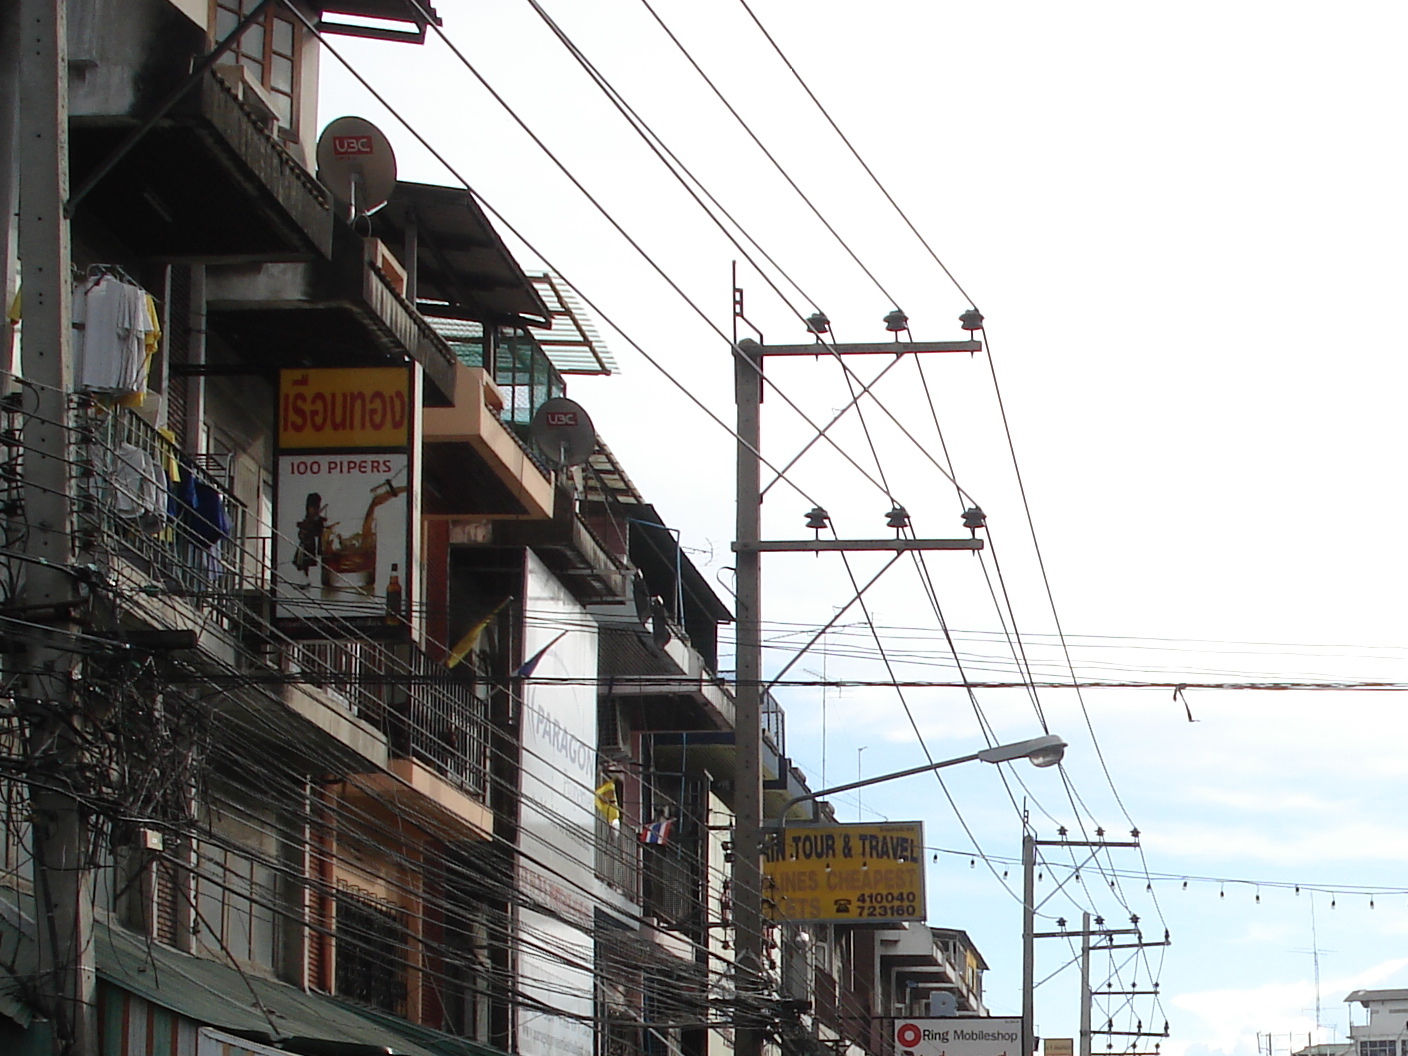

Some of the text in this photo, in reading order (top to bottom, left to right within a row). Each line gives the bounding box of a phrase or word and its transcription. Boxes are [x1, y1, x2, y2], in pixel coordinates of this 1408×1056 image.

[336, 139, 370, 152] UBC
[283, 373, 406, 433] เรือนทอง
[291, 459, 392, 474] 100 PIPERS
[535, 703, 594, 781] PARAGON
[791, 834, 837, 861] TOUR
[842, 834, 853, 858] &
[858, 834, 919, 864] TRAVEL
[827, 868, 917, 892] CHEAPEST
[856, 891, 917, 904] 410040
[856, 904, 916, 917] 723160
[922, 1029, 1018, 1043] Ring Mobileshop
